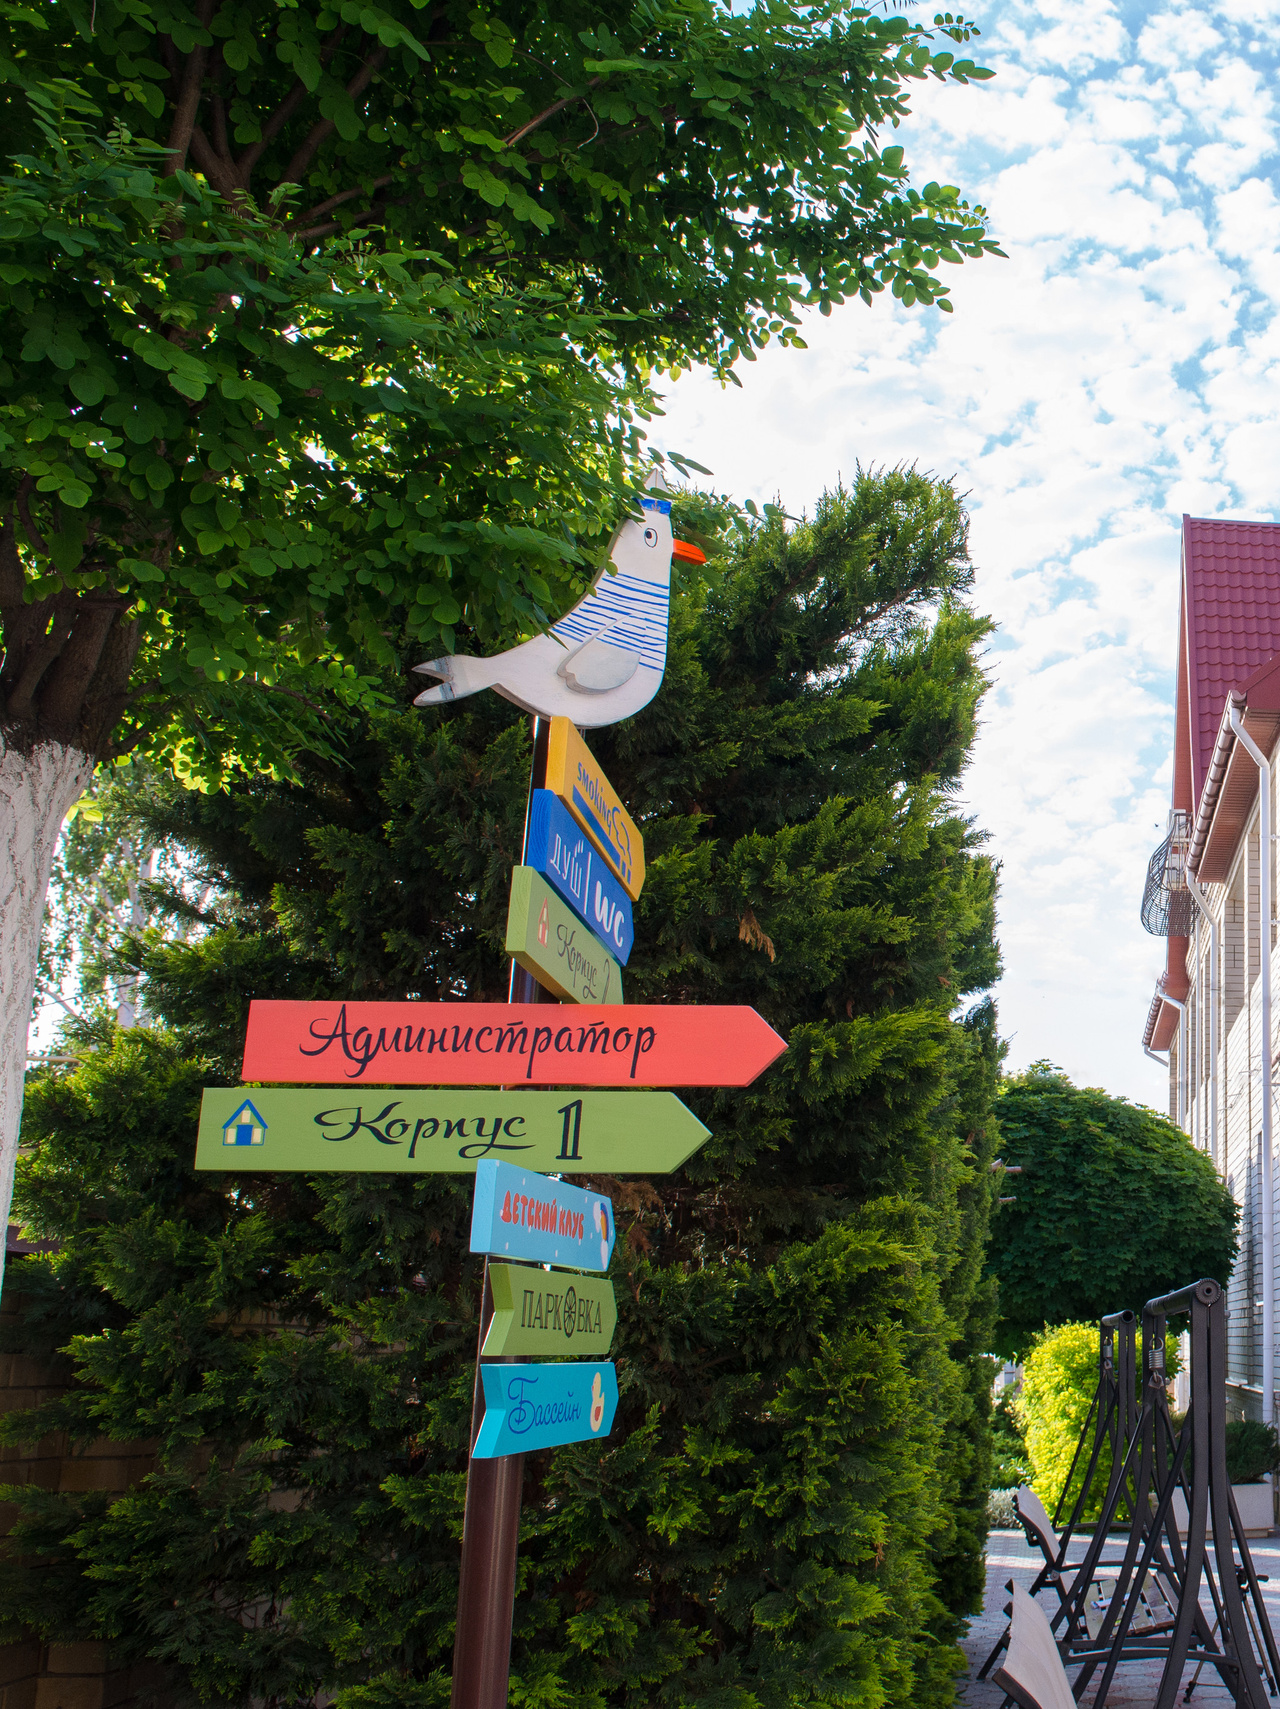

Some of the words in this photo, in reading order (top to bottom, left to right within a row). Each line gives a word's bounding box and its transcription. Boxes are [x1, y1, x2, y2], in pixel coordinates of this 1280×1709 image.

[556, 923, 598, 1000] Корпус
[299, 1003, 657, 1079] Администратор
[313, 1101, 537, 1159] Корпус
[555, 1099, 583, 1160] 1
[500, 1190, 558, 1235] ДЕТСКИЙ
[558, 1208, 585, 1241] КЛУБ
[520, 1286, 602, 1338] ПАРКОВКА
[507, 1377, 582, 1435] Бассейн
